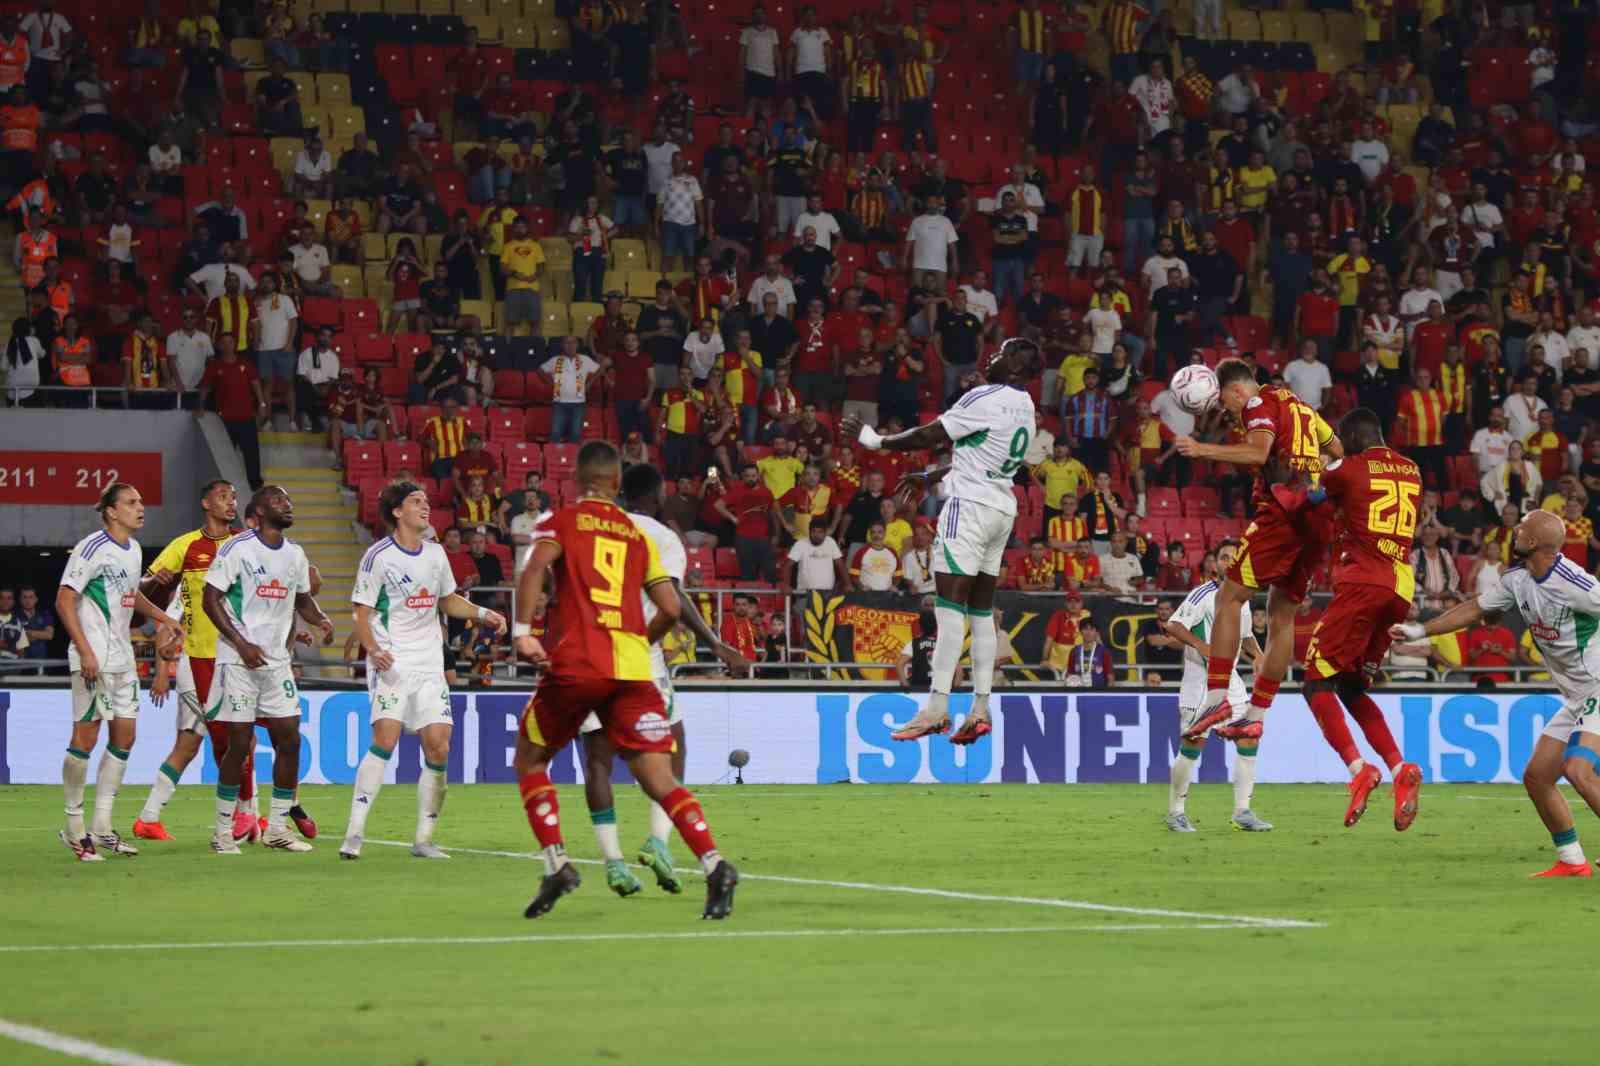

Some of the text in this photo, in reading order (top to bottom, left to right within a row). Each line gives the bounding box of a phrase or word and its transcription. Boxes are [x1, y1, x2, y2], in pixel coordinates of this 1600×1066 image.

[1289, 403, 1319, 457] 13
[1368, 479, 1420, 537] 26
[590, 536, 627, 607] 9
[816, 694, 1229, 784] ISONEM
